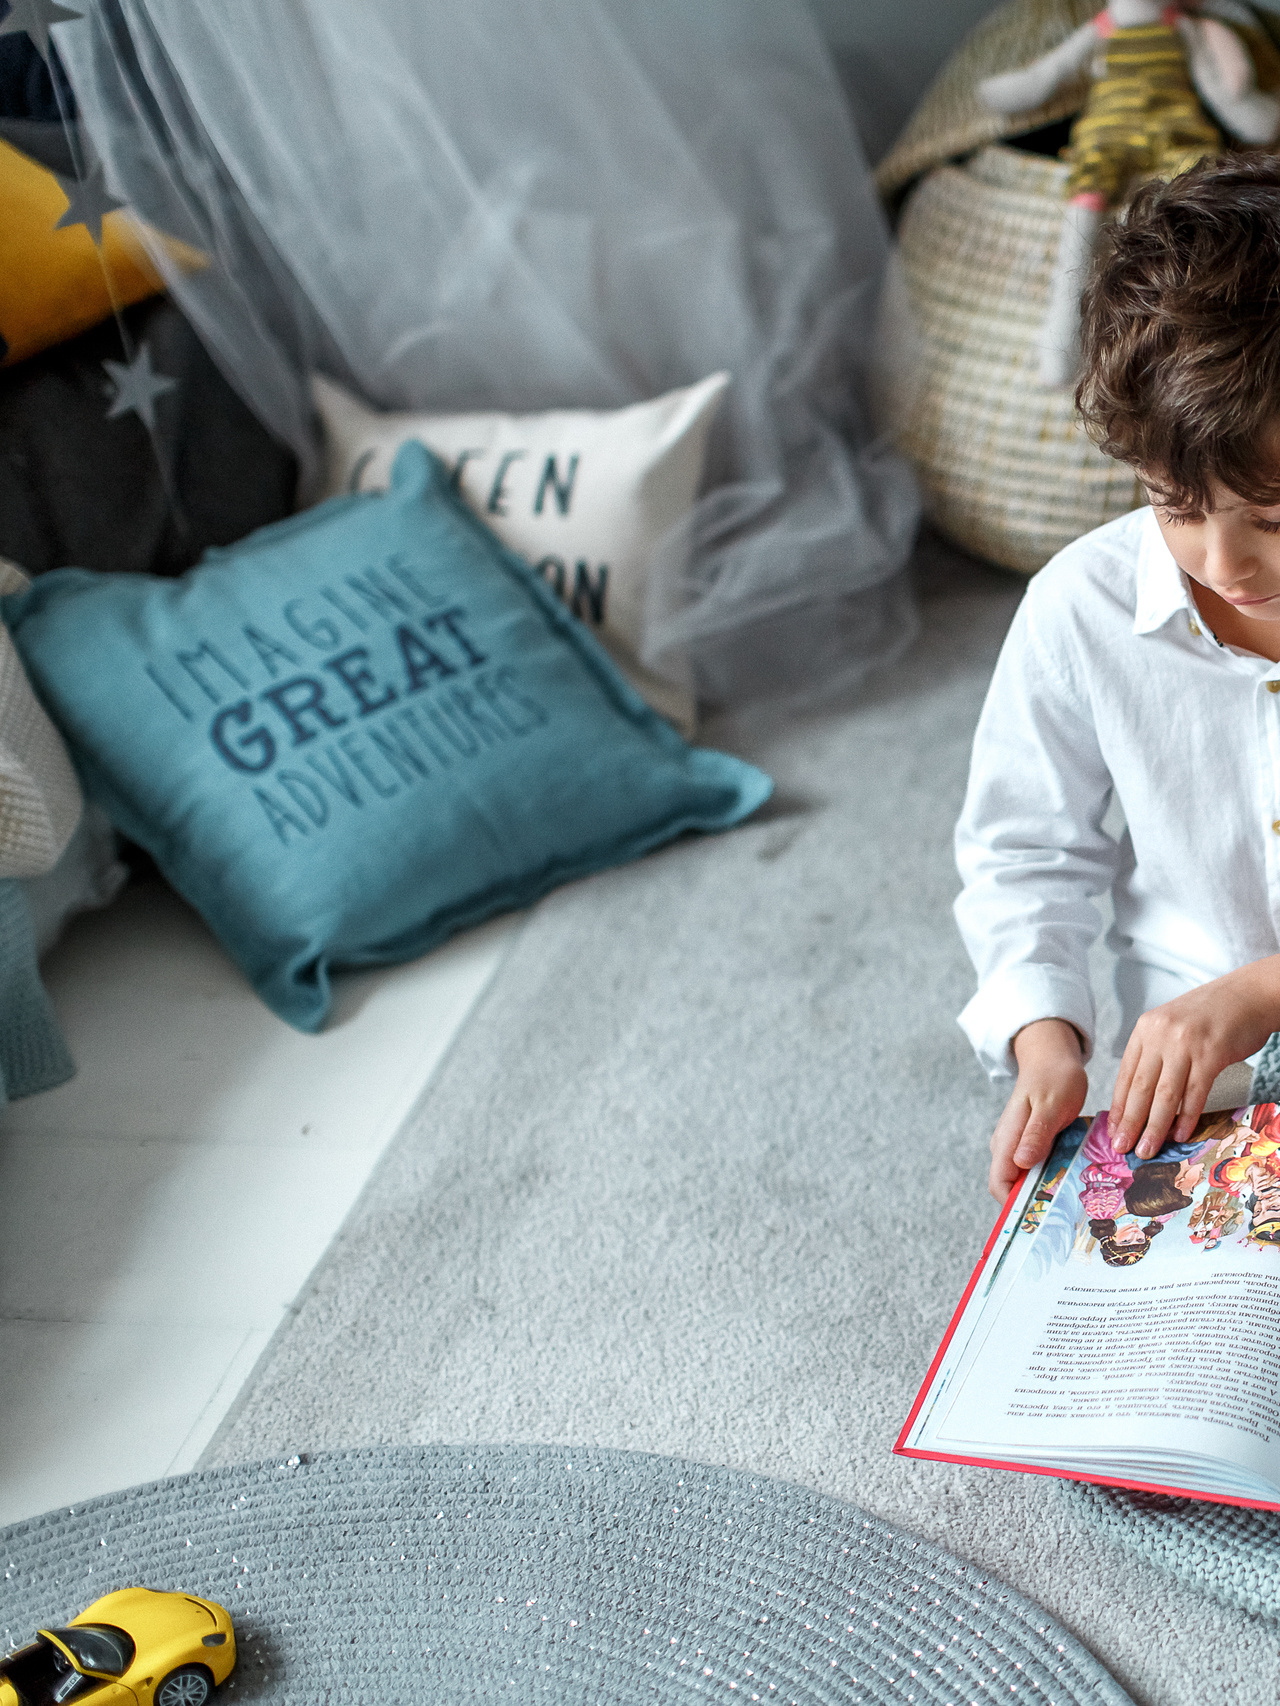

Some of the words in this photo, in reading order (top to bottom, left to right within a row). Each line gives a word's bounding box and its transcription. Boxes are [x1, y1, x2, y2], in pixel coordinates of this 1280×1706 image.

[145, 552, 447, 721] IMAGINE
[209, 604, 488, 776] GREAT
[252, 665, 551, 847] ADVENTURES
[1194, 1278, 1240, 1287] покраснел
[1229, 1294, 1279, 1307] приподнял
[1047, 1321, 1098, 1331] серебряные
[1217, 1317, 1243, 1325] слуги
[1046, 1351, 1074, 1359] людей
[1226, 1351, 1259, 1362] король
[1229, 1343, 1280, 1361] королевств
[1234, 1369, 1277, 1387] радостью
